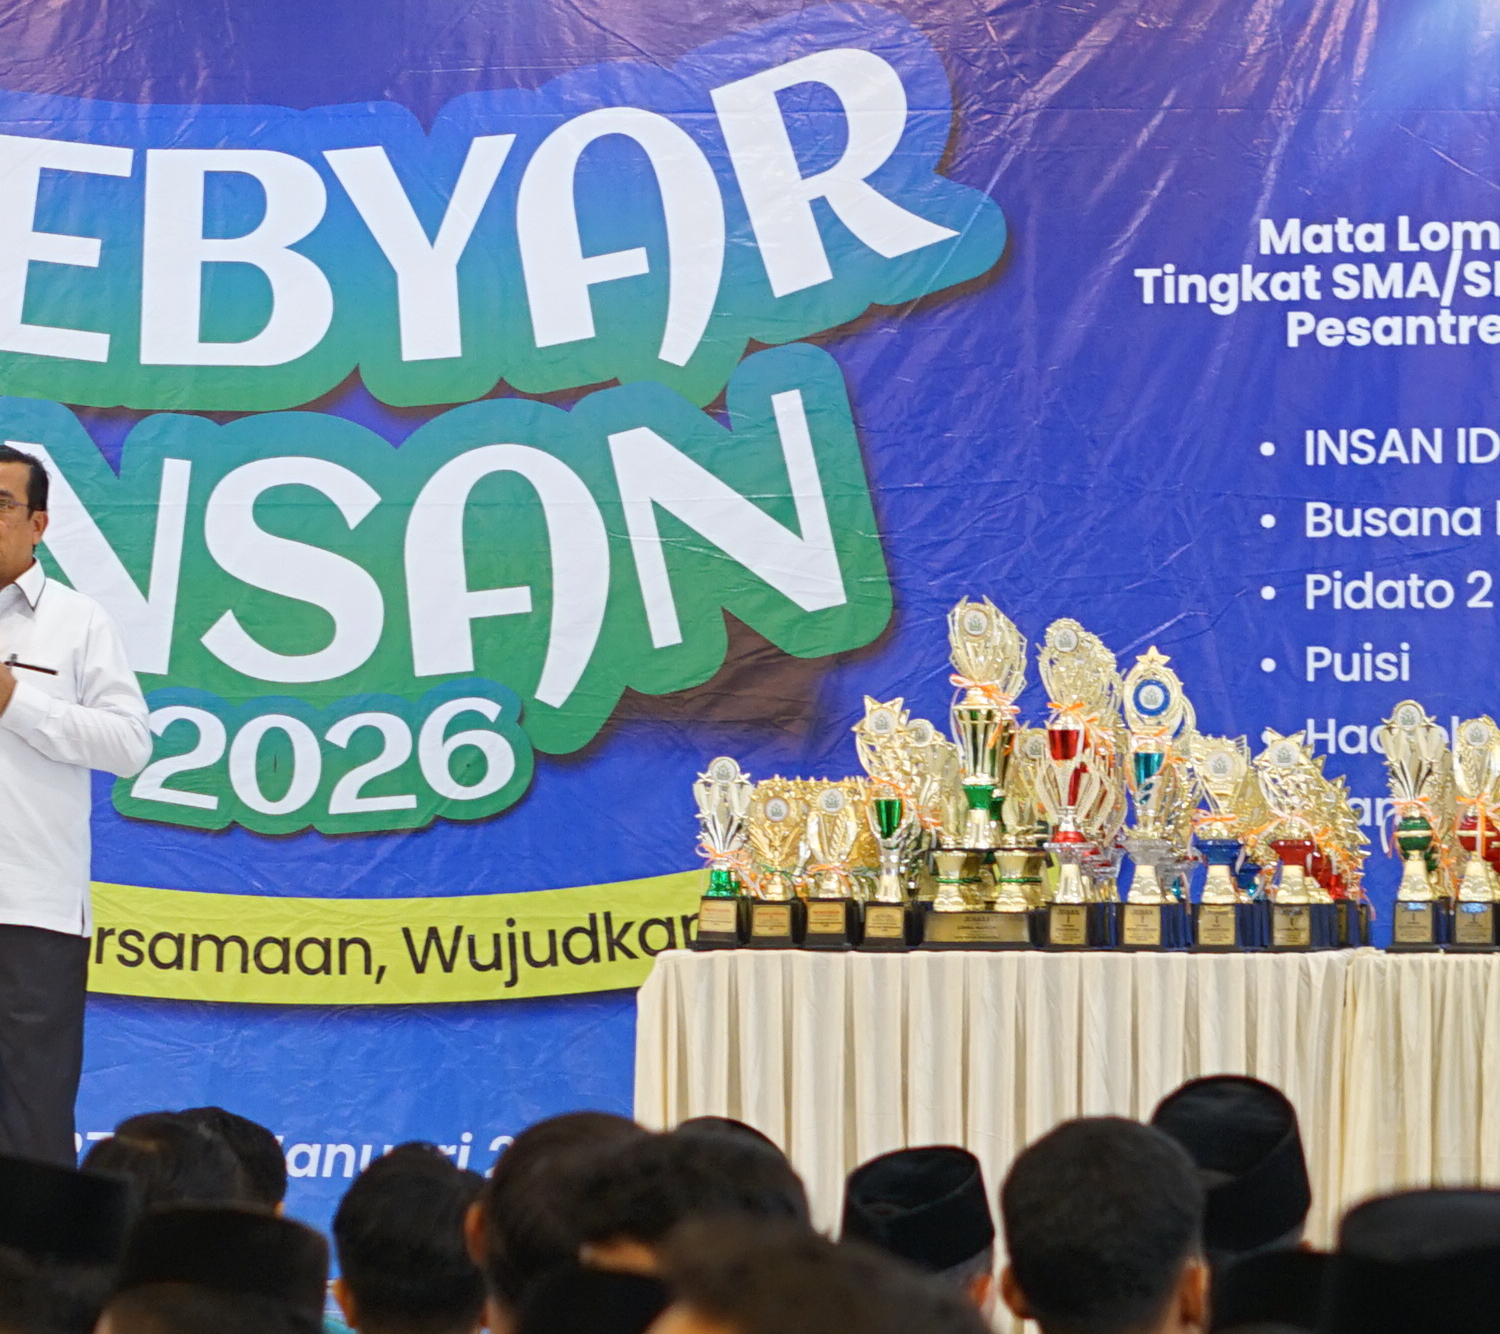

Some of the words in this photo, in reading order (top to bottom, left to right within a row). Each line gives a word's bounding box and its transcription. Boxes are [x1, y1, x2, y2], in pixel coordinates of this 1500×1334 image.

[1260, 217, 1385, 255] Mata
[1135, 263, 1321, 315] Tingkat
[1305, 427, 1443, 466] INSAN
[1305, 501, 1482, 538] Busana
[1305, 570, 1455, 610] Pidato
[1466, 569, 1494, 608] 2
[1306, 642, 1410, 682] Puisi
[130, 696, 517, 815] 2026
